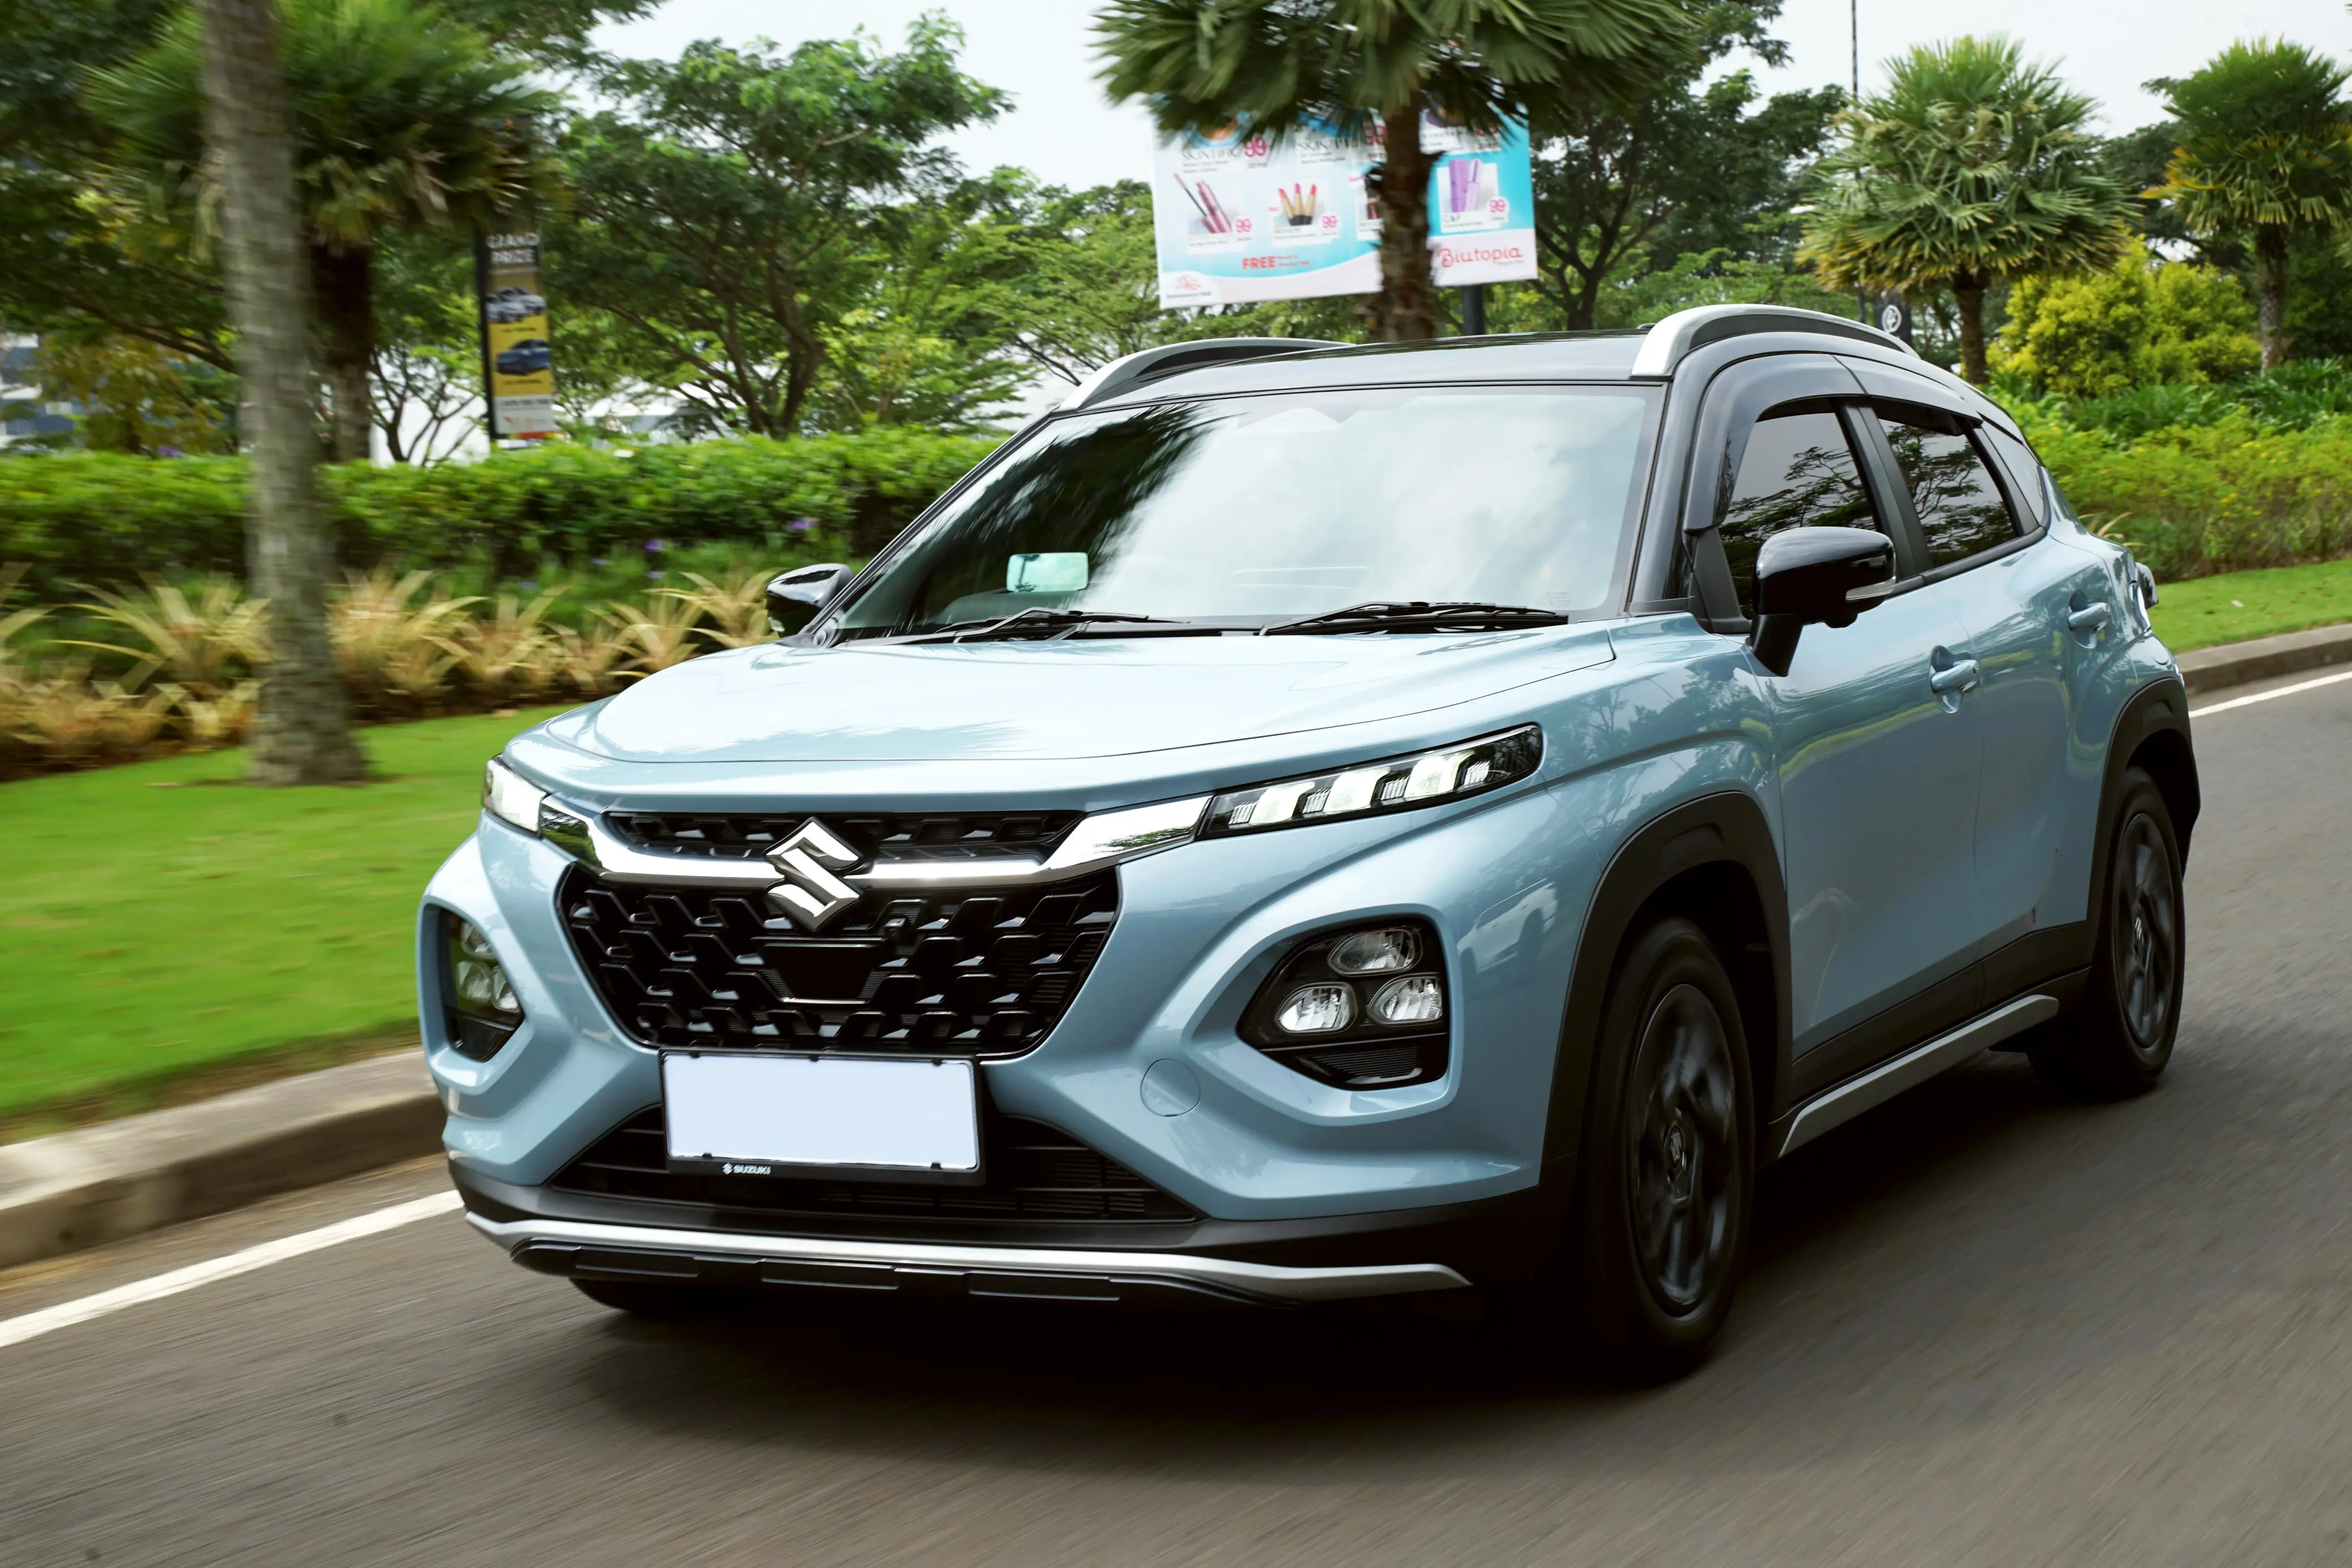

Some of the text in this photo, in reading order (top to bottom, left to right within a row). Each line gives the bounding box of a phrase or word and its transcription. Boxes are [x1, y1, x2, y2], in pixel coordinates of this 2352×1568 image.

[1490, 198, 1506, 213] 99
[1236, 219, 1252, 233] 99
[1322, 215, 1337, 228] 99
[1242, 256, 1276, 270] FREE
[1438, 247, 1524, 268] Biutopia
[733, 1164, 771, 1175] SUZUKI
